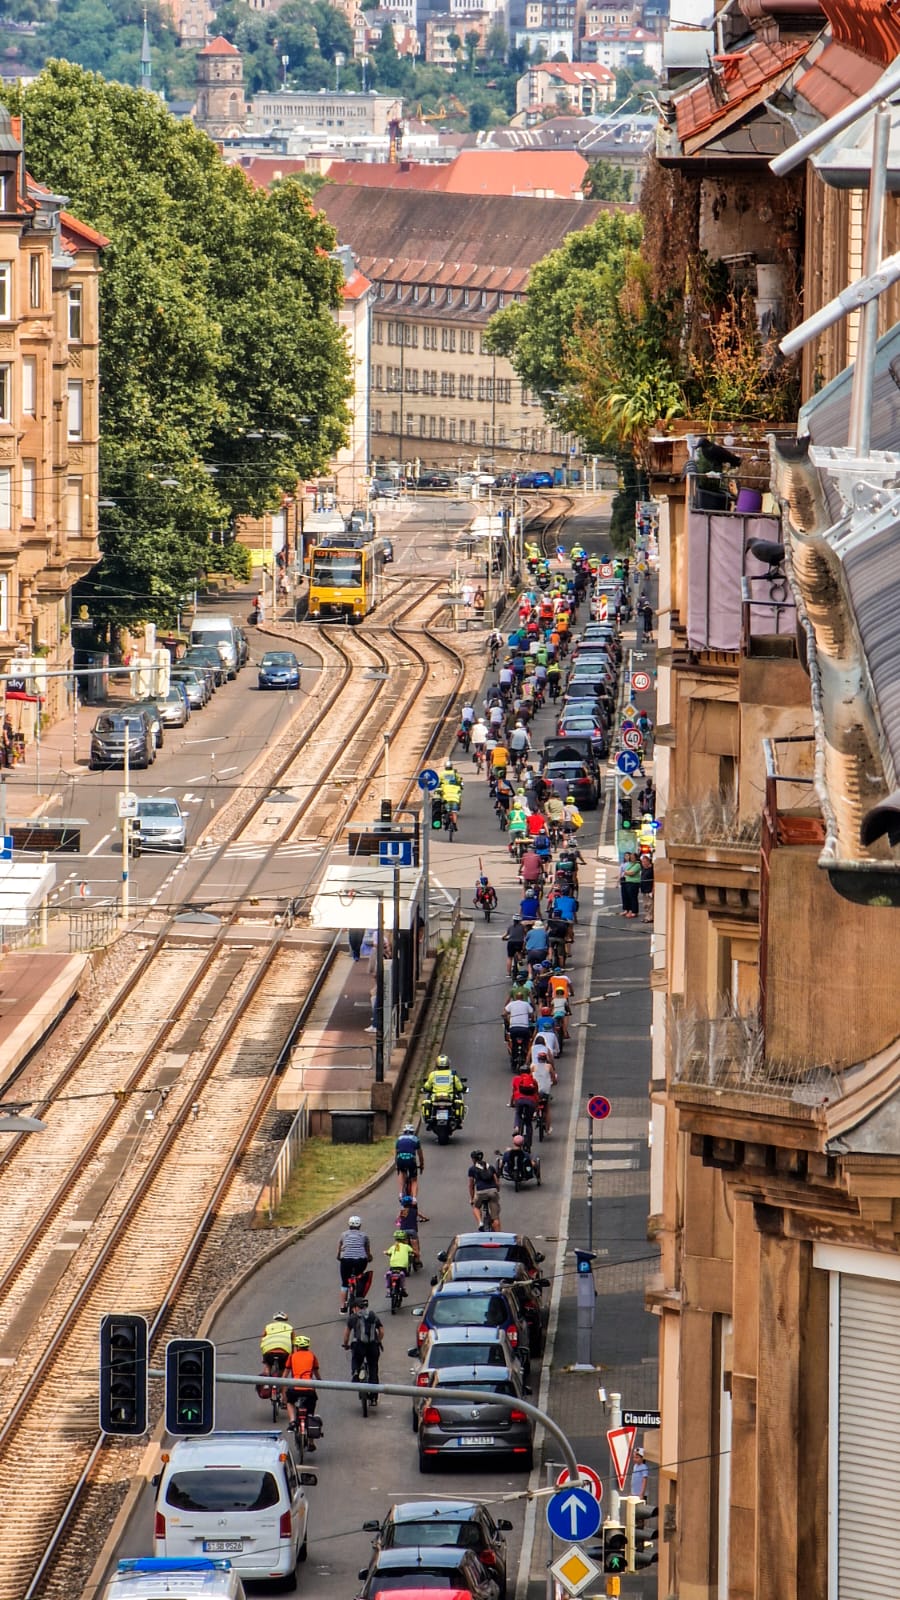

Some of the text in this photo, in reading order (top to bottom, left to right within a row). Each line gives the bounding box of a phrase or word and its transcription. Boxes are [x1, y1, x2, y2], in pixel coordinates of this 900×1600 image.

[8, 679, 24, 689] sky
[636, 677, 646, 685] 40
[628, 733, 639, 743] 40
[624, 1413, 661, 1424] Claudius
